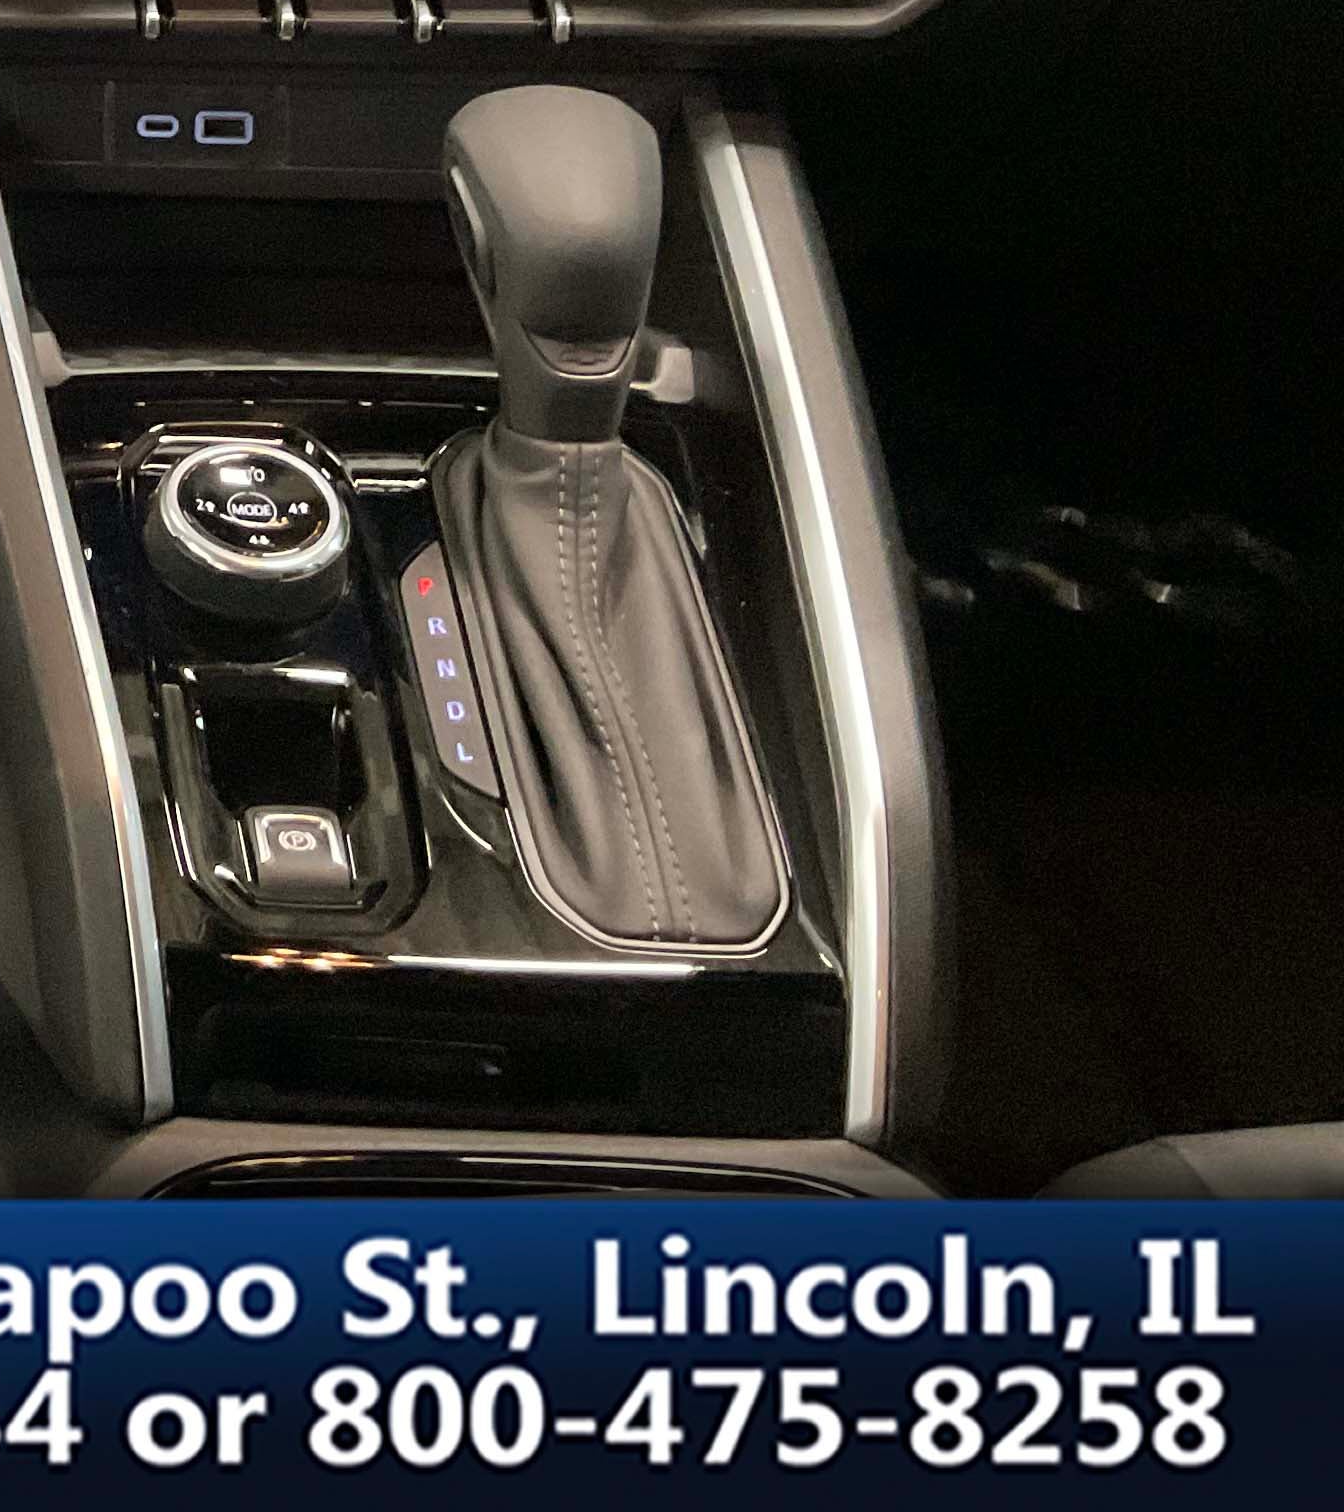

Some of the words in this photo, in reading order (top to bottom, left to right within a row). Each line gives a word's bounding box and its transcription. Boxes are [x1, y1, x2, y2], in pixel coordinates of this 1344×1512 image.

[232, 503, 273, 517] MODE
[417, 576, 433, 596] P
[427, 616, 448, 636] R
[436, 657, 457, 678] N
[446, 700, 466, 721] D
[456, 741, 474, 763] L
